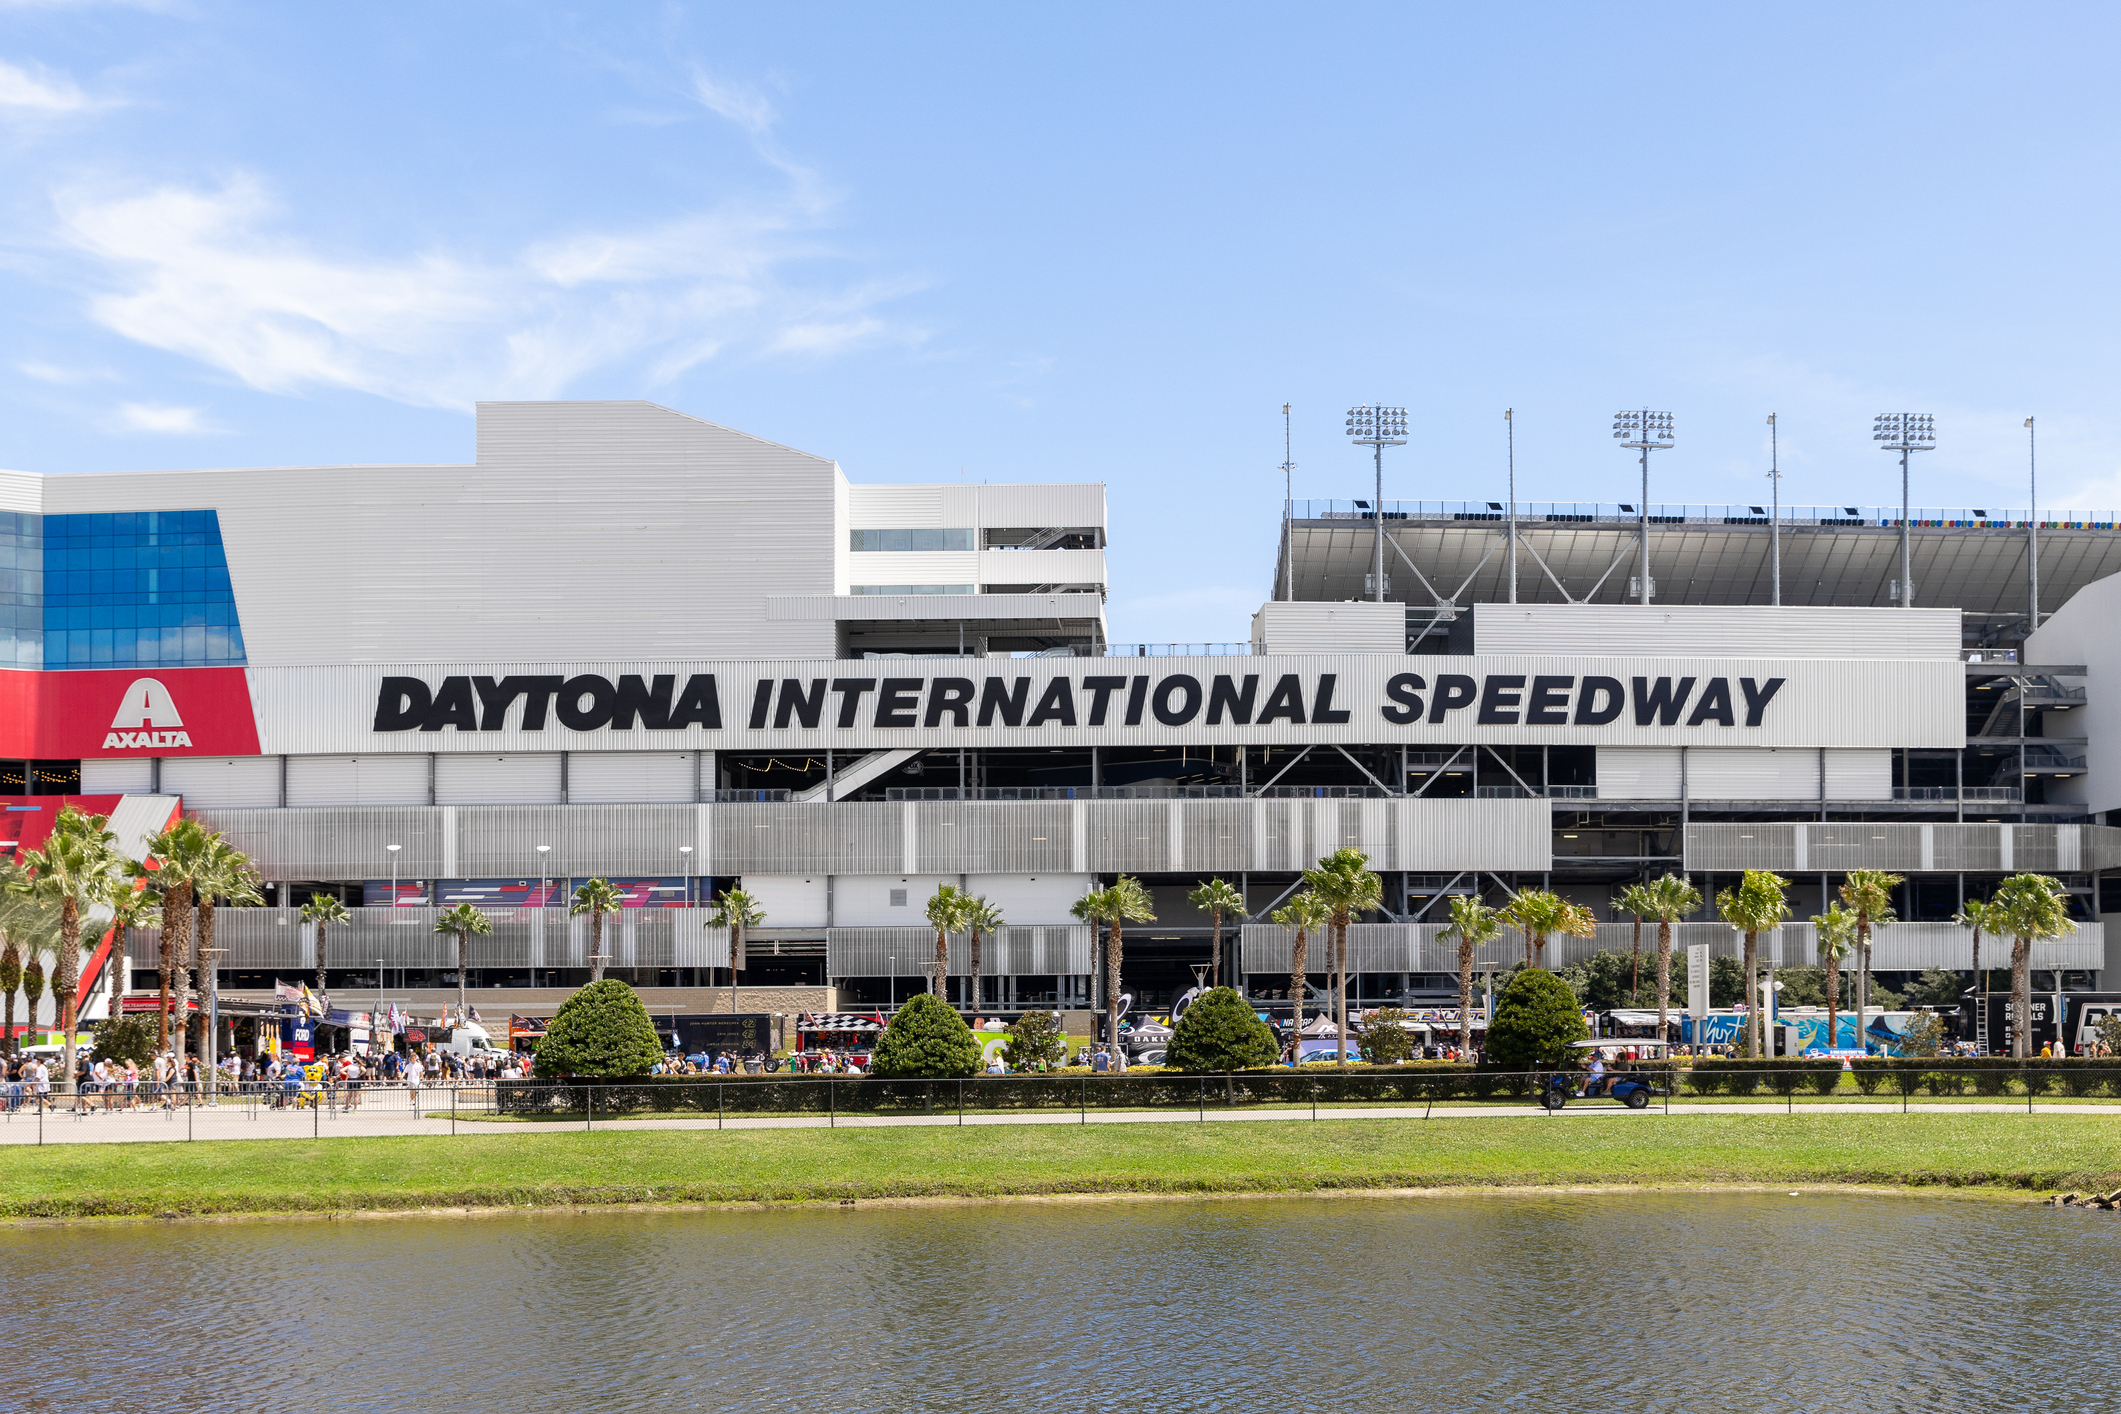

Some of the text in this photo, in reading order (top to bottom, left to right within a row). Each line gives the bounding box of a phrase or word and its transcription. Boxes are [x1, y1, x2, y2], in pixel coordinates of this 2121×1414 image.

[373, 673, 1786, 732] DAYTONA INTERNATIONAL SPEEDWAY
[102, 731, 193, 749] AXALTA
[741, 1018, 757, 1029] 42
[294, 1028, 310, 1042] FORD
[741, 1029, 757, 1039] 43
[741, 1039, 757, 1049] 84
